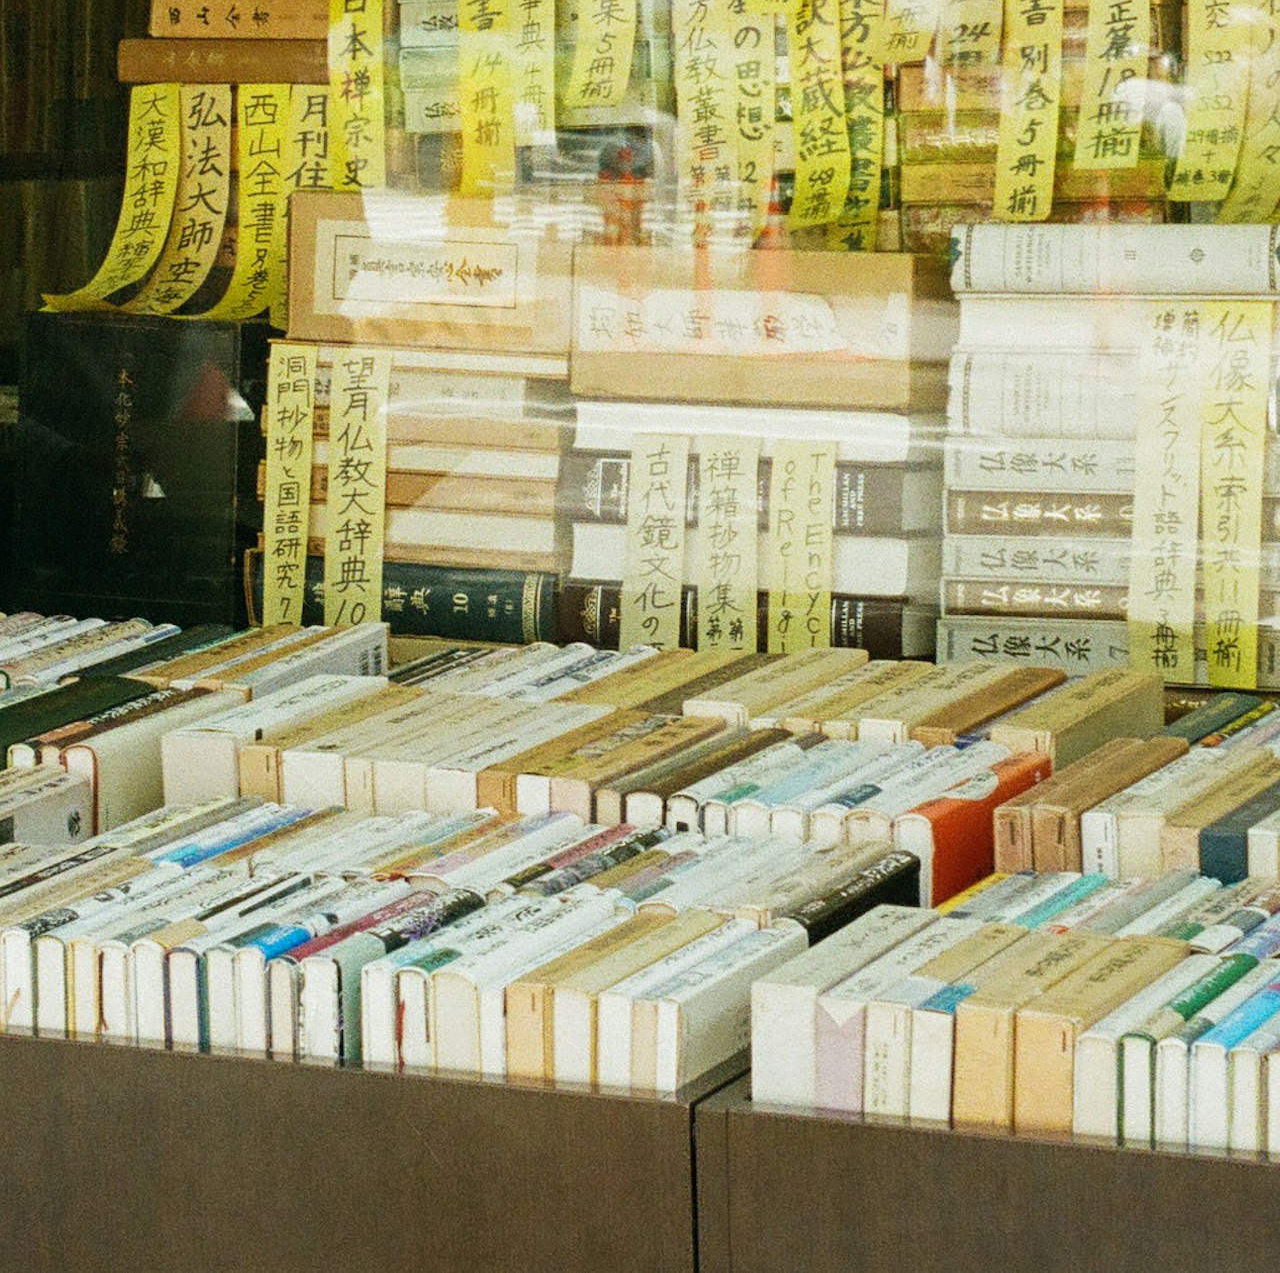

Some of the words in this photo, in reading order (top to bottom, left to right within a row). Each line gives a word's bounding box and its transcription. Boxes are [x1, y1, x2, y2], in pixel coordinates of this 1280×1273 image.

[273, 355, 312, 627] 洞門抄物と国語研究7
[633, 442, 680, 650] 古代鏡文化の
[971, 633, 1092, 663] 仏像大系
